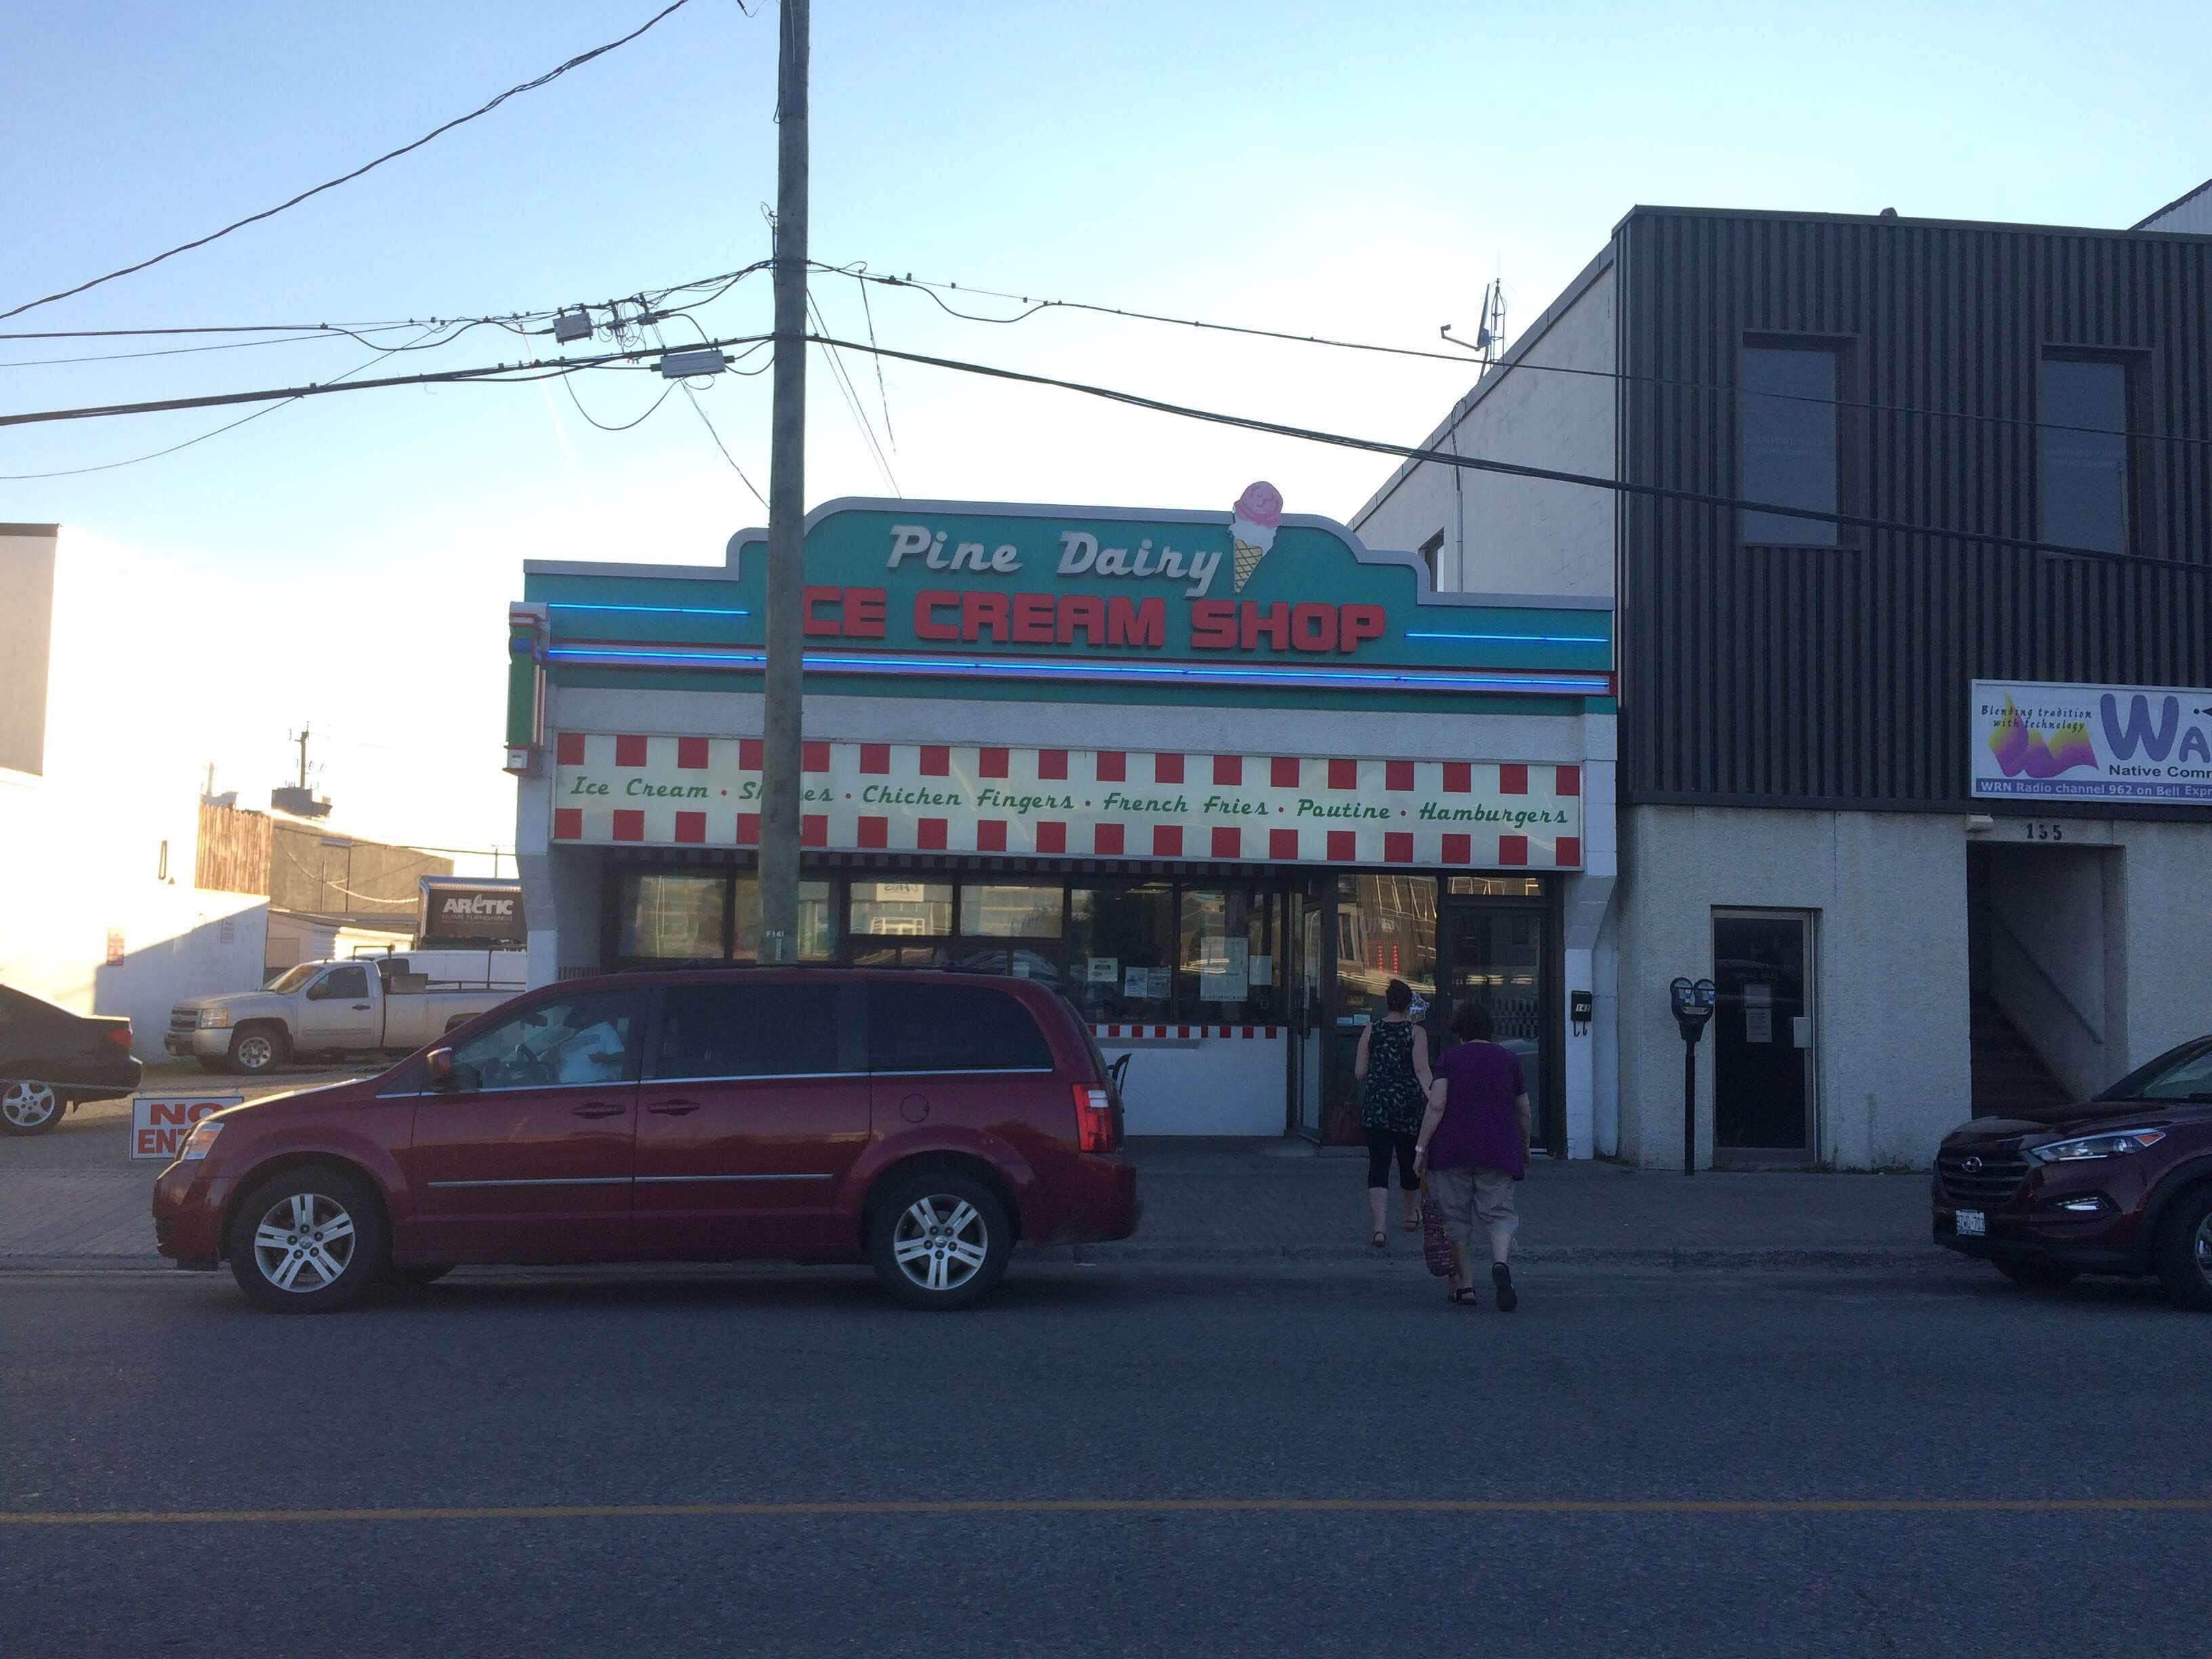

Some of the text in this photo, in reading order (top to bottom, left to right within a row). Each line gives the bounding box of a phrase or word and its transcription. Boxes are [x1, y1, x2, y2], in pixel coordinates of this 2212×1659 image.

[886, 524, 1223, 598] Pine Dairy
[802, 585, 1387, 653] CE CREAM SHOP
[1981, 704, 2092, 719] Blending tradition
[1993, 718, 2085, 733] with technology
[2100, 693, 2212, 764] WA
[2109, 764, 2162, 777] Native
[1981, 781, 2012, 792] WRN
[2016, 782, 2052, 793] Radio
[2056, 783, 2105, 794] channel
[2108, 784, 2133, 795] 962
[2137, 787, 2152, 796] on
[570, 776, 609, 796] Ice
[626, 778, 710, 798] Cream
[977, 788, 1075, 814] Fingers
[1103, 792, 1189, 813] French
[1204, 796, 1269, 815] Fries
[1296, 798, 1391, 819] Poutine
[1418, 802, 1568, 829] Hamburgers
[443, 895, 514, 915] ARCTIC
[150, 1102, 226, 1126] NO
